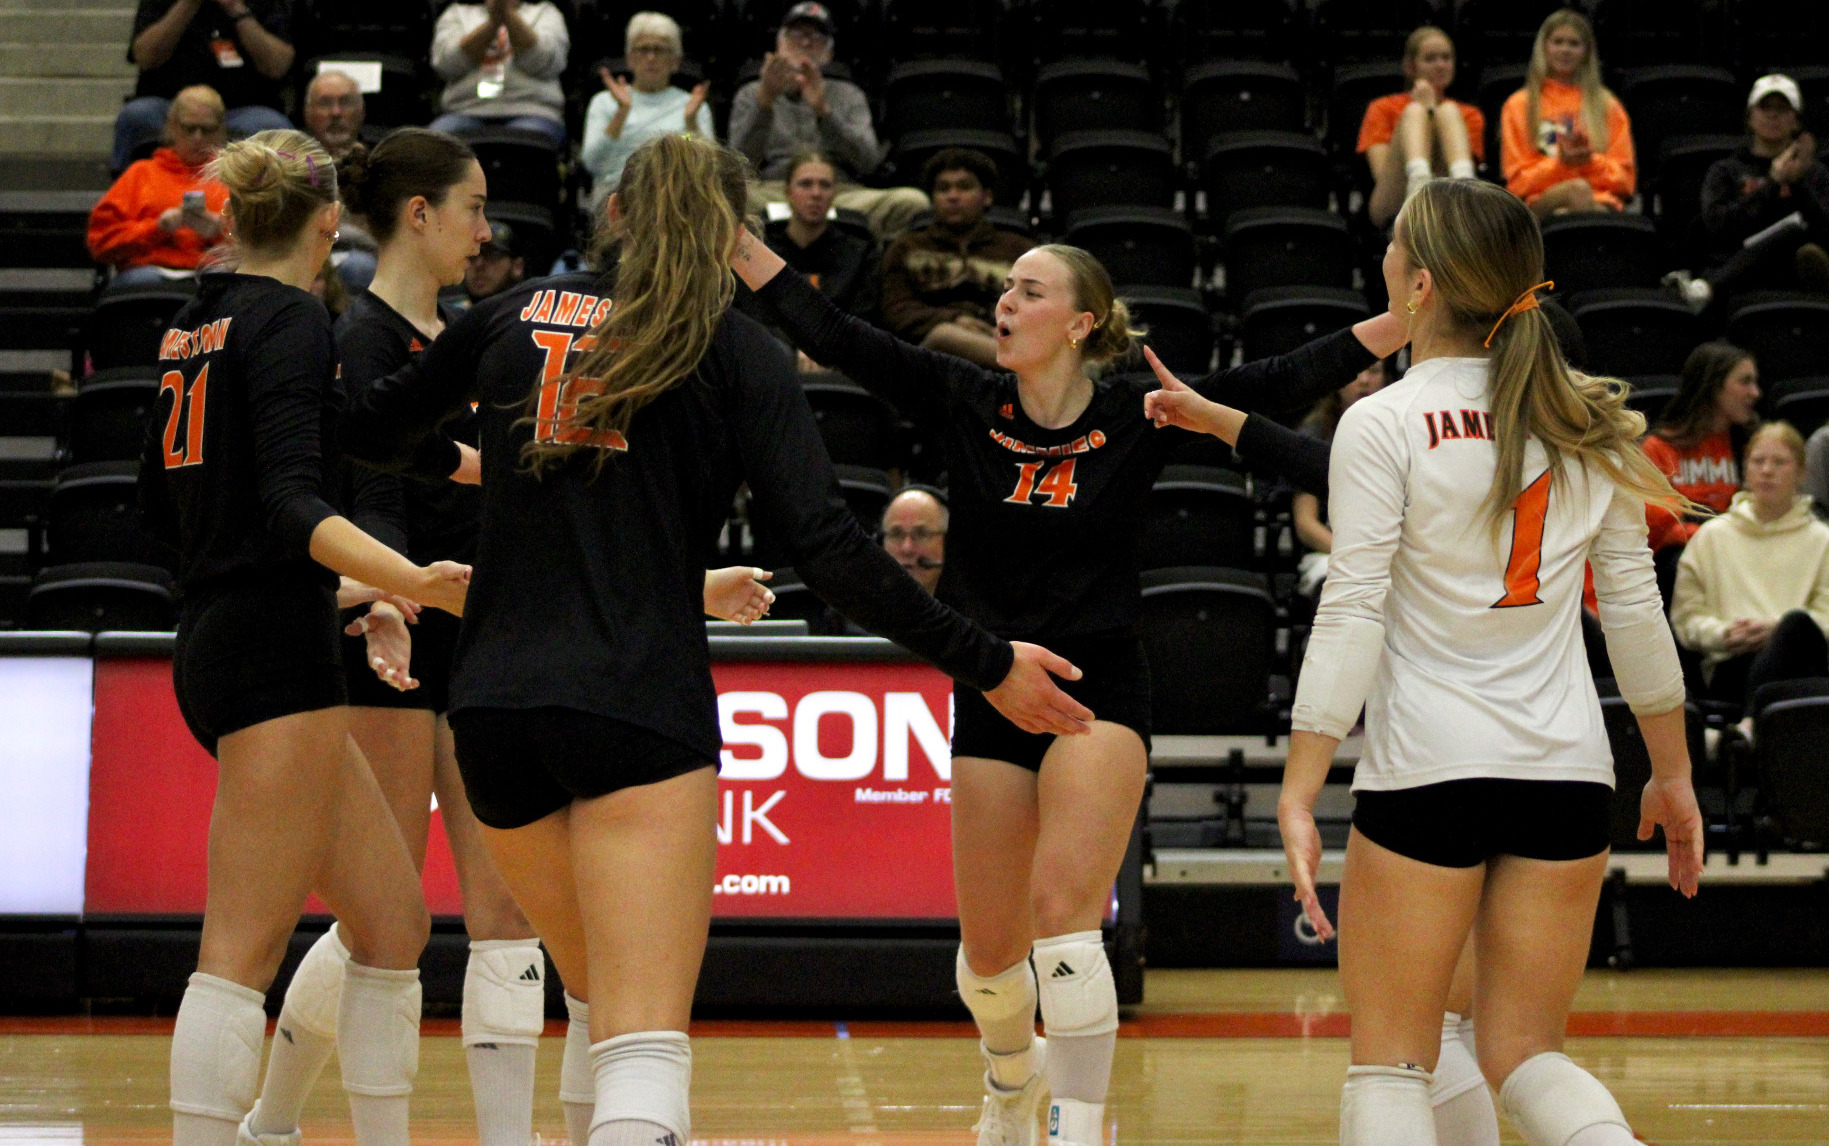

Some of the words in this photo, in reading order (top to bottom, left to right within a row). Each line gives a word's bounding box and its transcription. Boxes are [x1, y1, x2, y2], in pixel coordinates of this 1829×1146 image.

[160, 361, 209, 469] 21
[1002, 457, 1078, 508] 14
[1488, 467, 1552, 608] 1
[854, 787, 929, 803] Member
